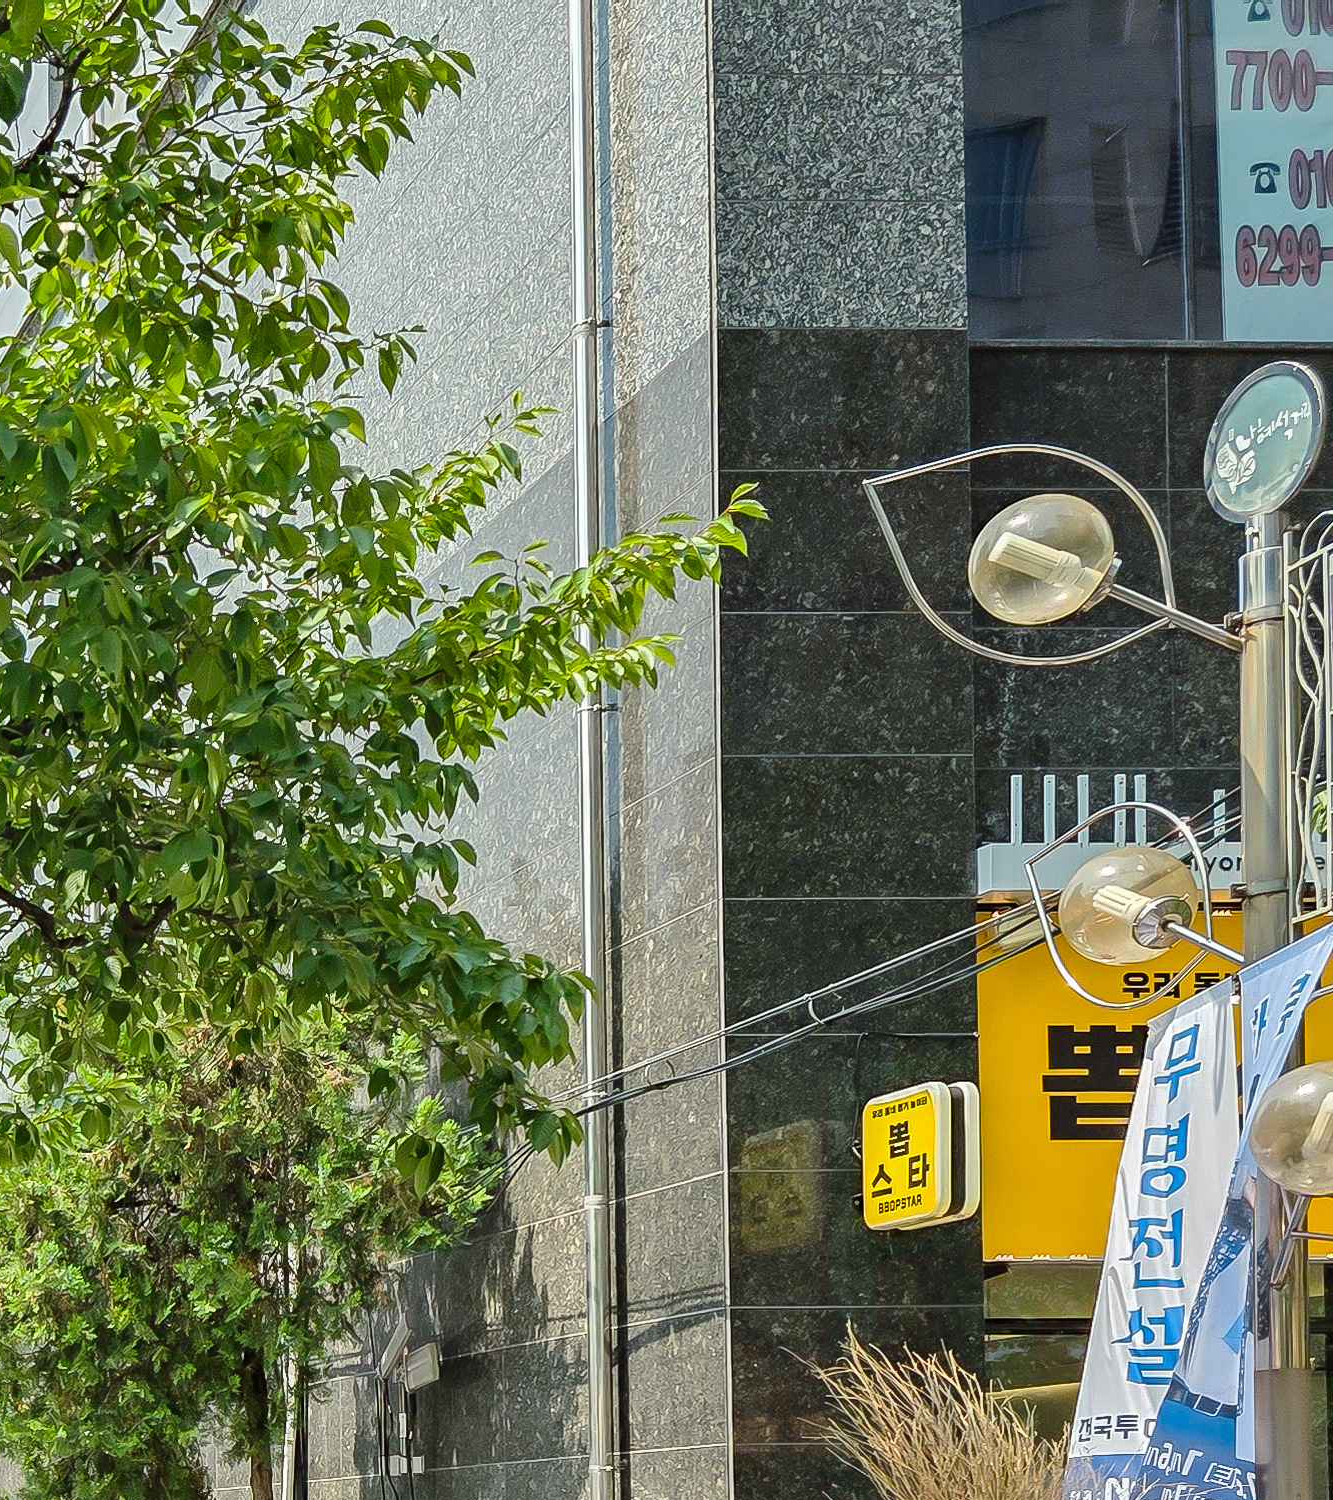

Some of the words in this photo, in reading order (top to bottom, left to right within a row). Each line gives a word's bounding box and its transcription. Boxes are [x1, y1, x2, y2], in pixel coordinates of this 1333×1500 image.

[1122, 971, 1181, 999] 우리
[878, 1193, 923, 1214] BBOPSTAR
[1111, 1023, 1202, 1385] 무명전설
